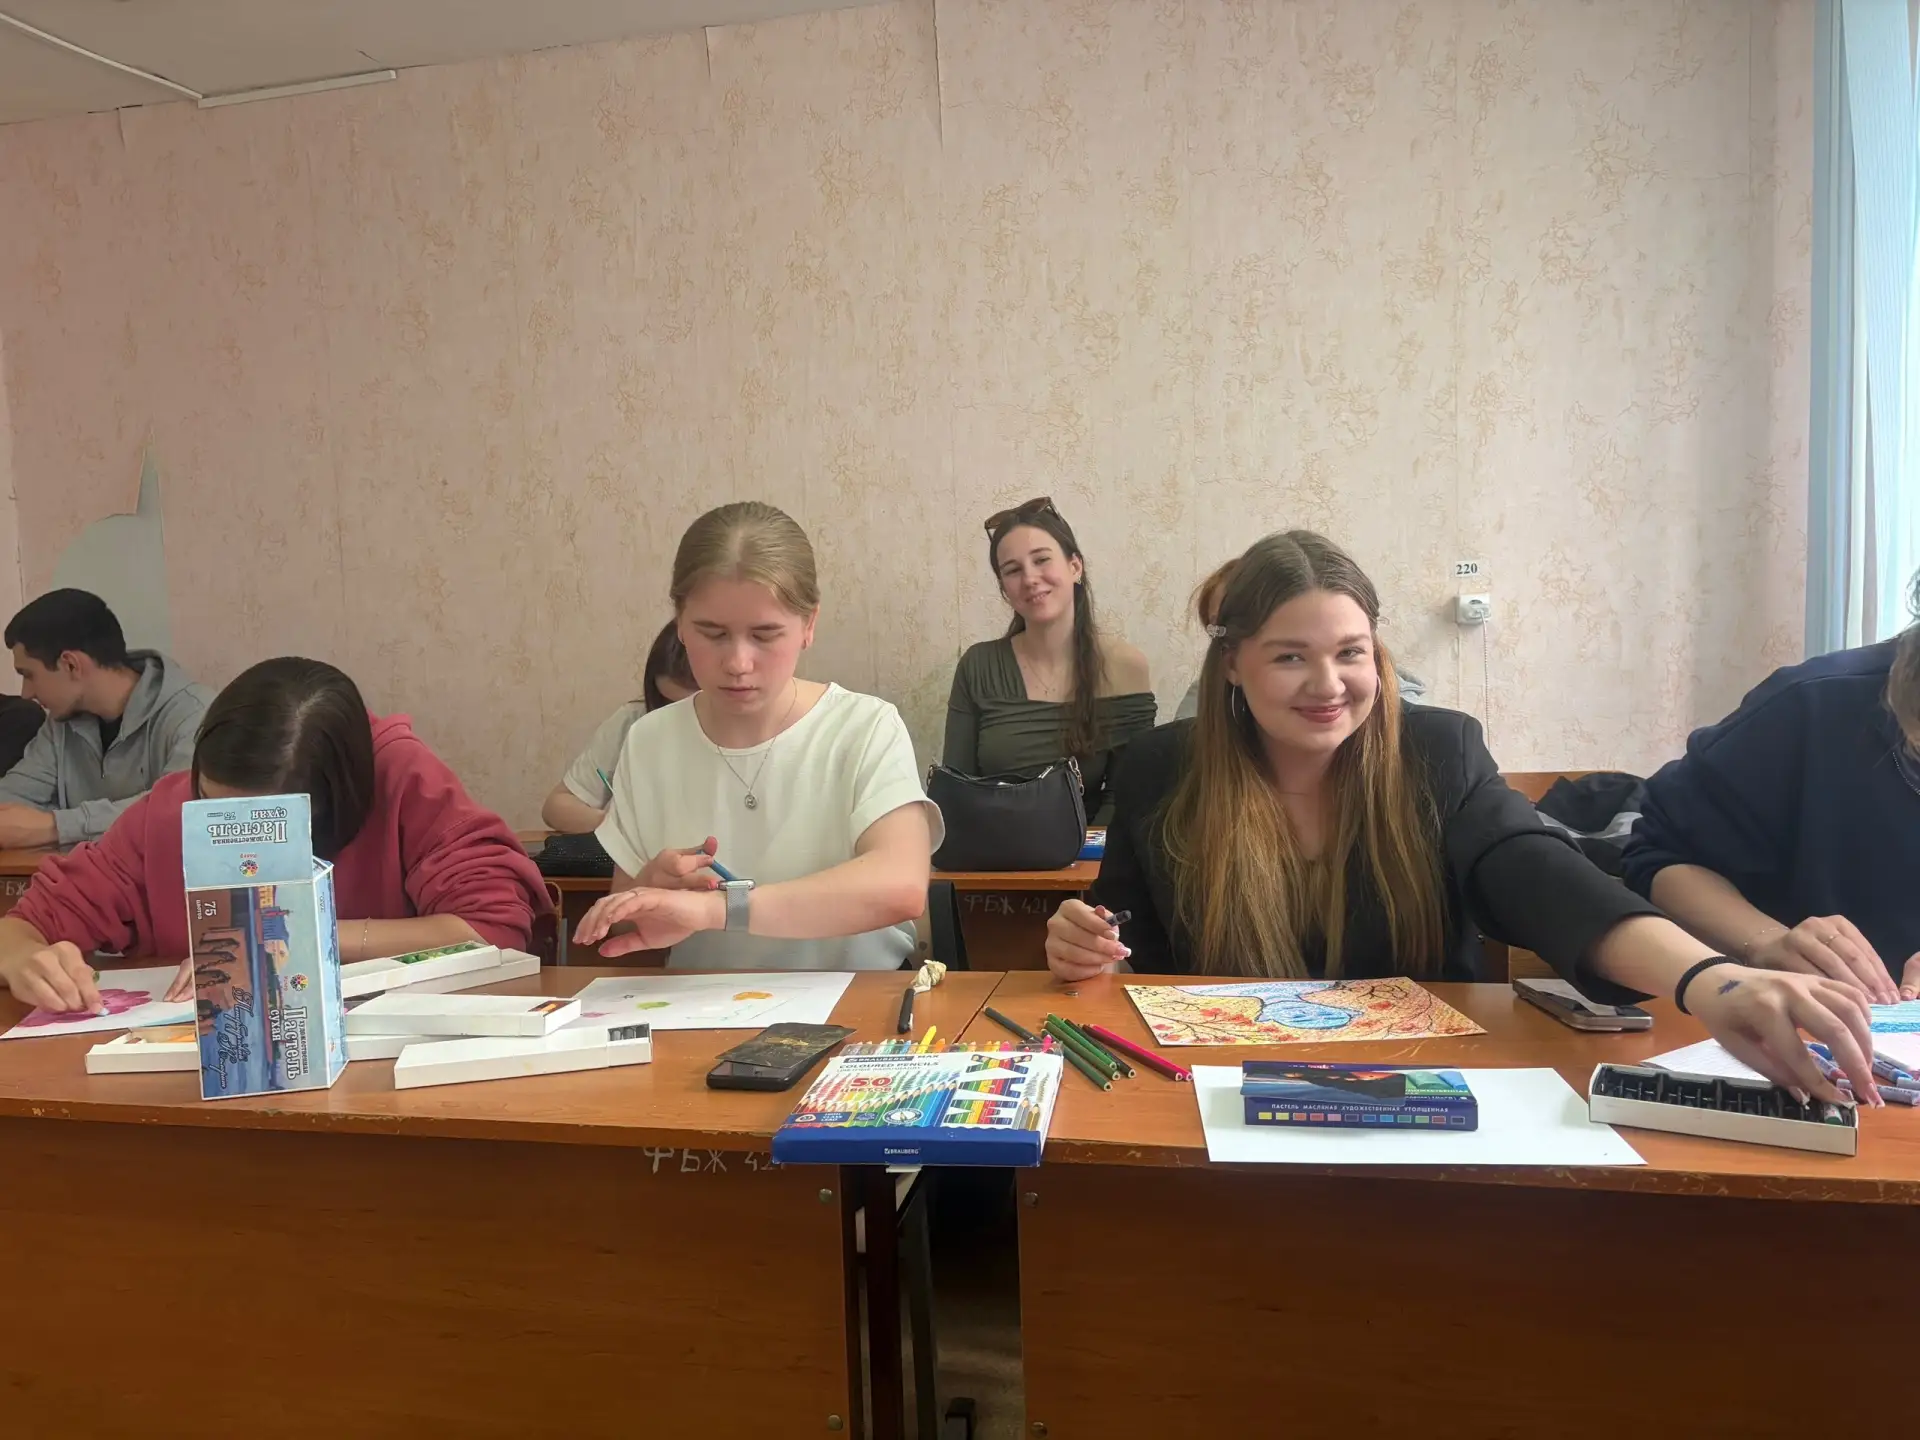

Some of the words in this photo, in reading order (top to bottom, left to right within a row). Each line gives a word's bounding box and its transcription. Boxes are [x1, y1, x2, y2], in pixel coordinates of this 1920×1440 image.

[1456, 563, 1478, 575] 220
[224, 812, 236, 820] 75
[251, 807, 287, 819] сухая
[207, 820, 287, 843] Пастель
[1, 881, 27, 896] БЖ
[204, 900, 217, 916] 75
[1021, 897, 1047, 914] 421
[268, 1009, 281, 1042] сухая
[283, 1006, 307, 1080] Пастель
[851, 1077, 892, 1087] 50
[744, 1150, 785, 1172] 42
